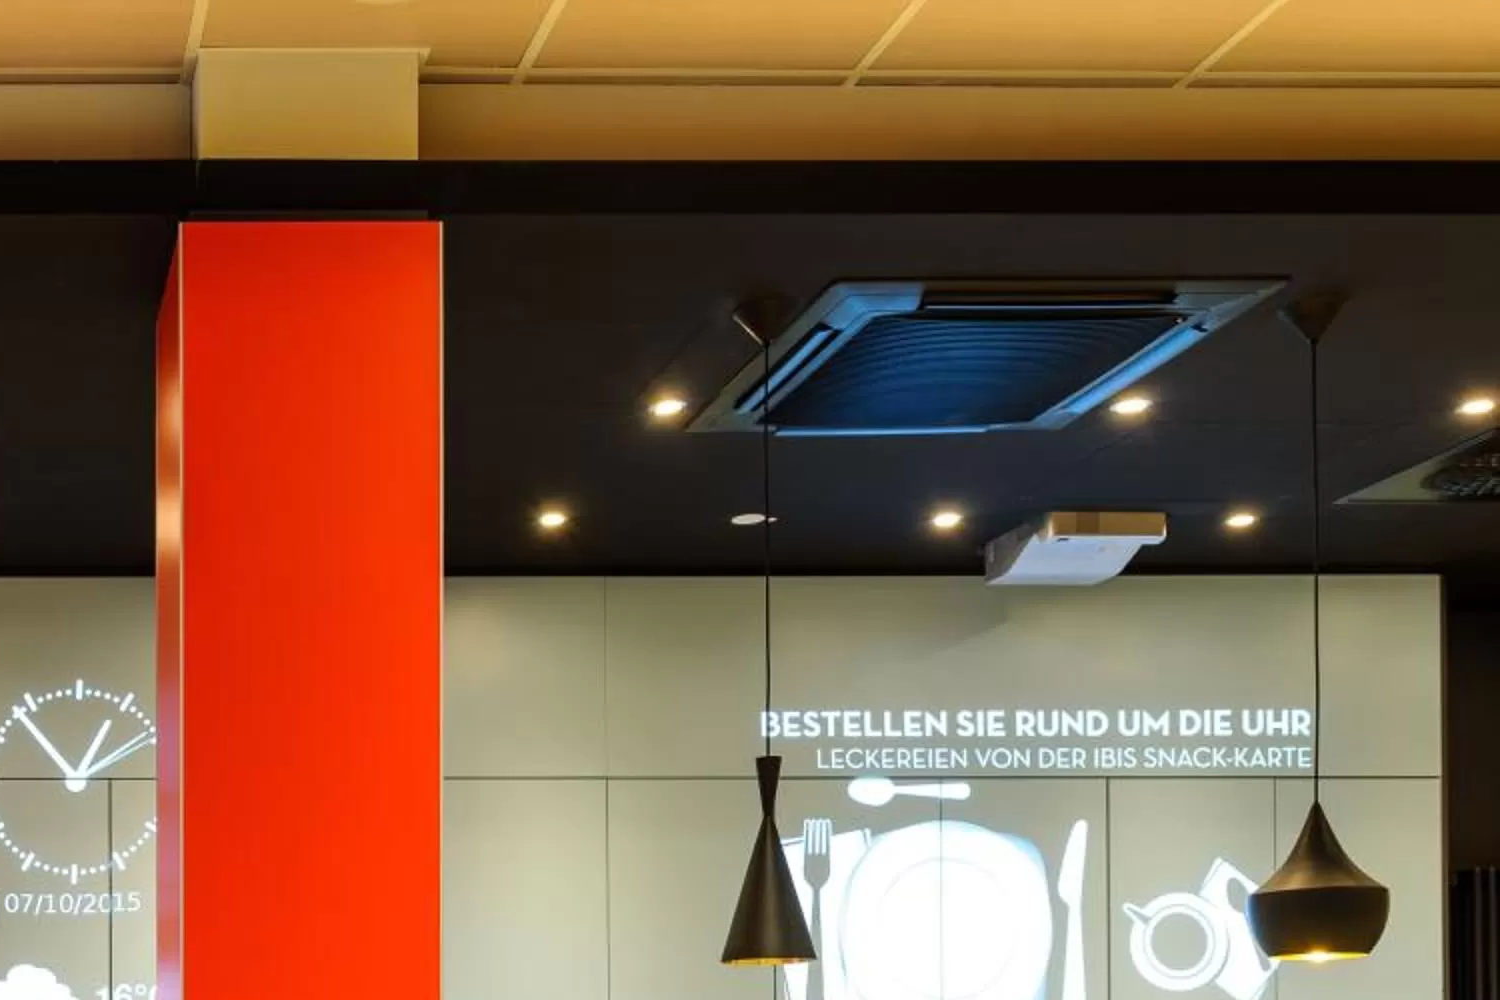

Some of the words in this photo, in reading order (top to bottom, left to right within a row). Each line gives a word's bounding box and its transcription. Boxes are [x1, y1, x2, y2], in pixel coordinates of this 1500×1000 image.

[760, 710, 948, 737] BESTELLEN
[956, 711, 1005, 736] SIE
[1015, 710, 1109, 736] RUND
[1117, 710, 1172, 737] UM
[1180, 709, 1233, 736] DIE
[1241, 709, 1311, 736] UHR
[817, 748, 968, 769] LECKEREIEN
[975, 748, 1031, 769] VON
[1039, 748, 1087, 769] DER
[1094, 748, 1137, 769] IBIS
[1143, 747, 1312, 769] SNACK-KARTE
[4, 893, 141, 913] 07/10/2015
